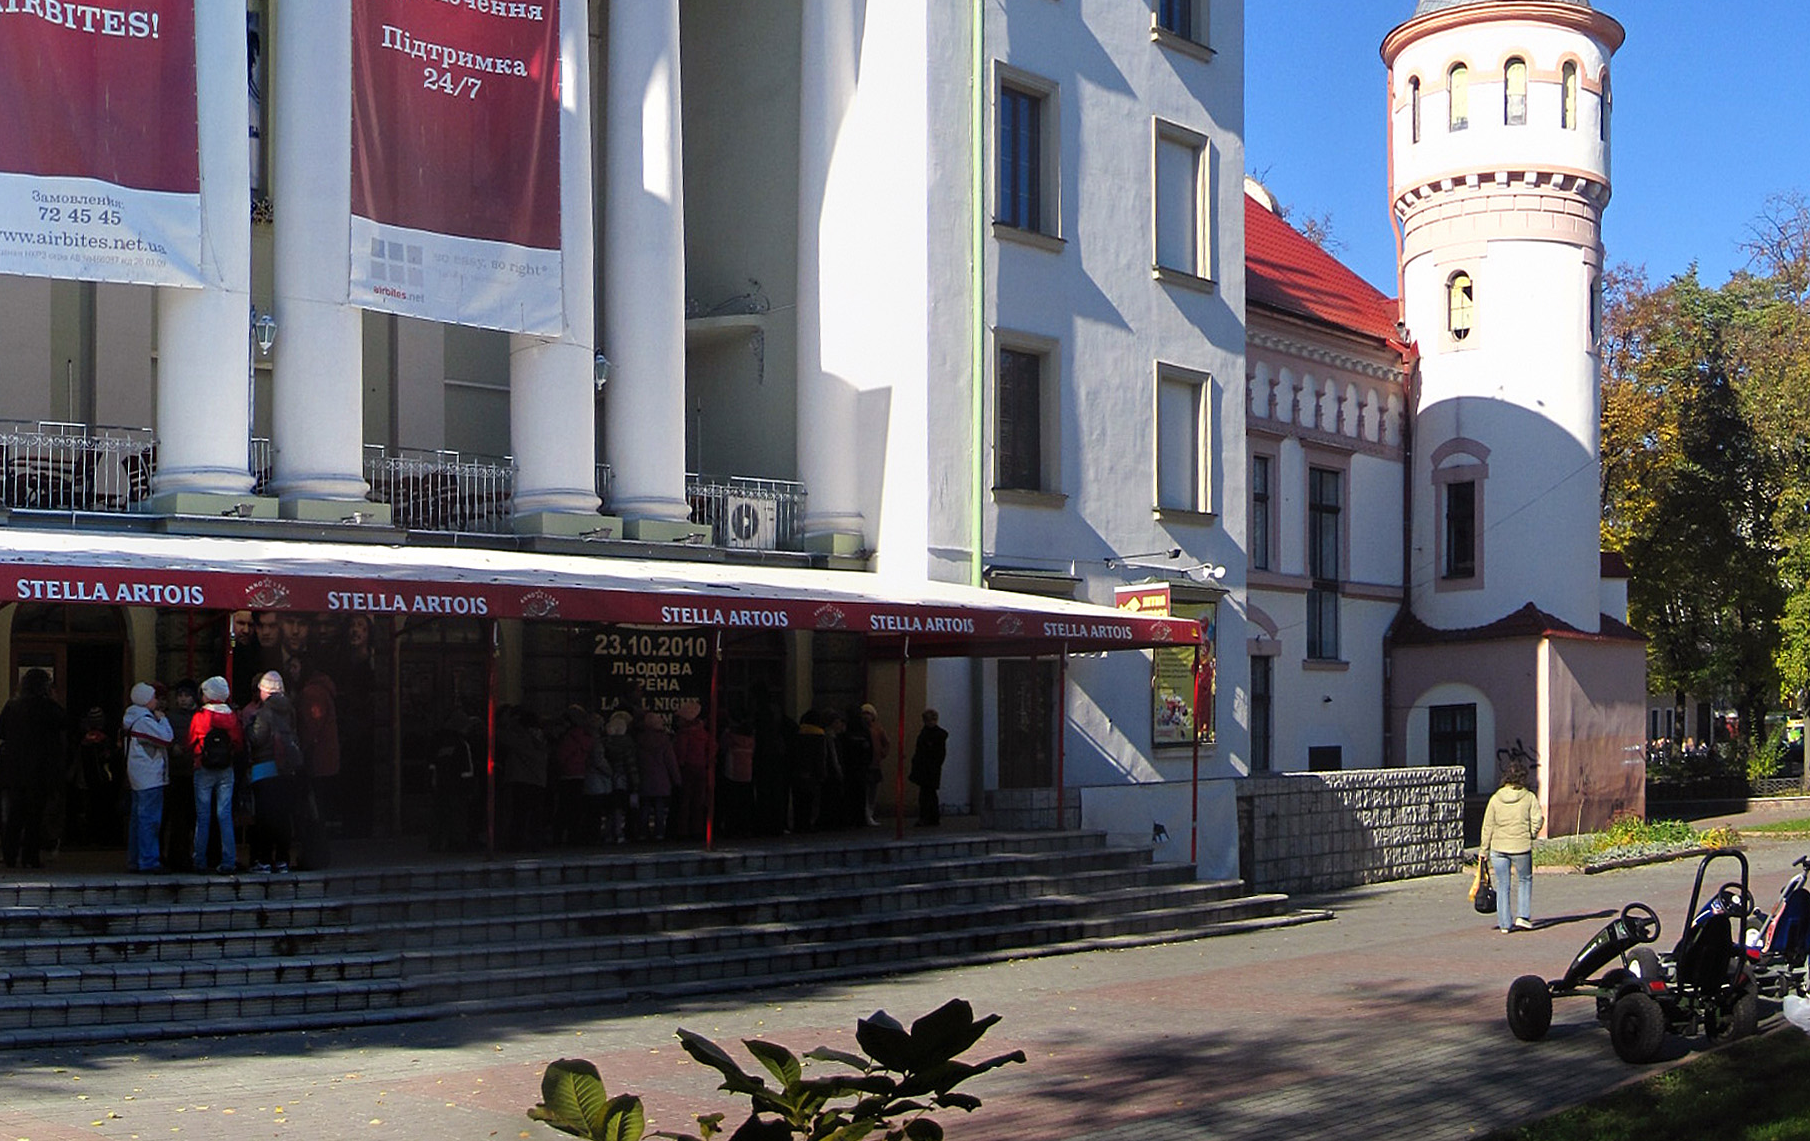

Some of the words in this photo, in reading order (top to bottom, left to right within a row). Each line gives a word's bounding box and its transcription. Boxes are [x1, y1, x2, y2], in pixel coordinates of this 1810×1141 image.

[381, 24, 528, 77] Підтримка
[423, 67, 482, 99] 24/7
[39, 207, 61, 222] 72
[68, 209, 91, 224] 45
[99, 211, 121, 225] 45
[373, 285, 424, 303] airbites.net
[16, 578, 110, 603] STELLA
[115, 583, 204, 606] ARTOIS
[327, 591, 408, 613] STELLA
[411, 594, 488, 616] ARTOIS
[661, 606, 726, 626] STELLA
[728, 609, 789, 627] ARTOIS
[869, 614, 923, 632] STELLA
[925, 616, 975, 633] ARTOIS
[1043, 622, 1088, 638] STELLA
[1090, 624, 1133, 640] ARTOIS
[594, 634, 707, 657] 23.10.2010
[611, 662, 692, 677] ЛЬОДОВА
[627, 678, 680, 691] РЕНА
[601, 697, 650, 710] LAL
